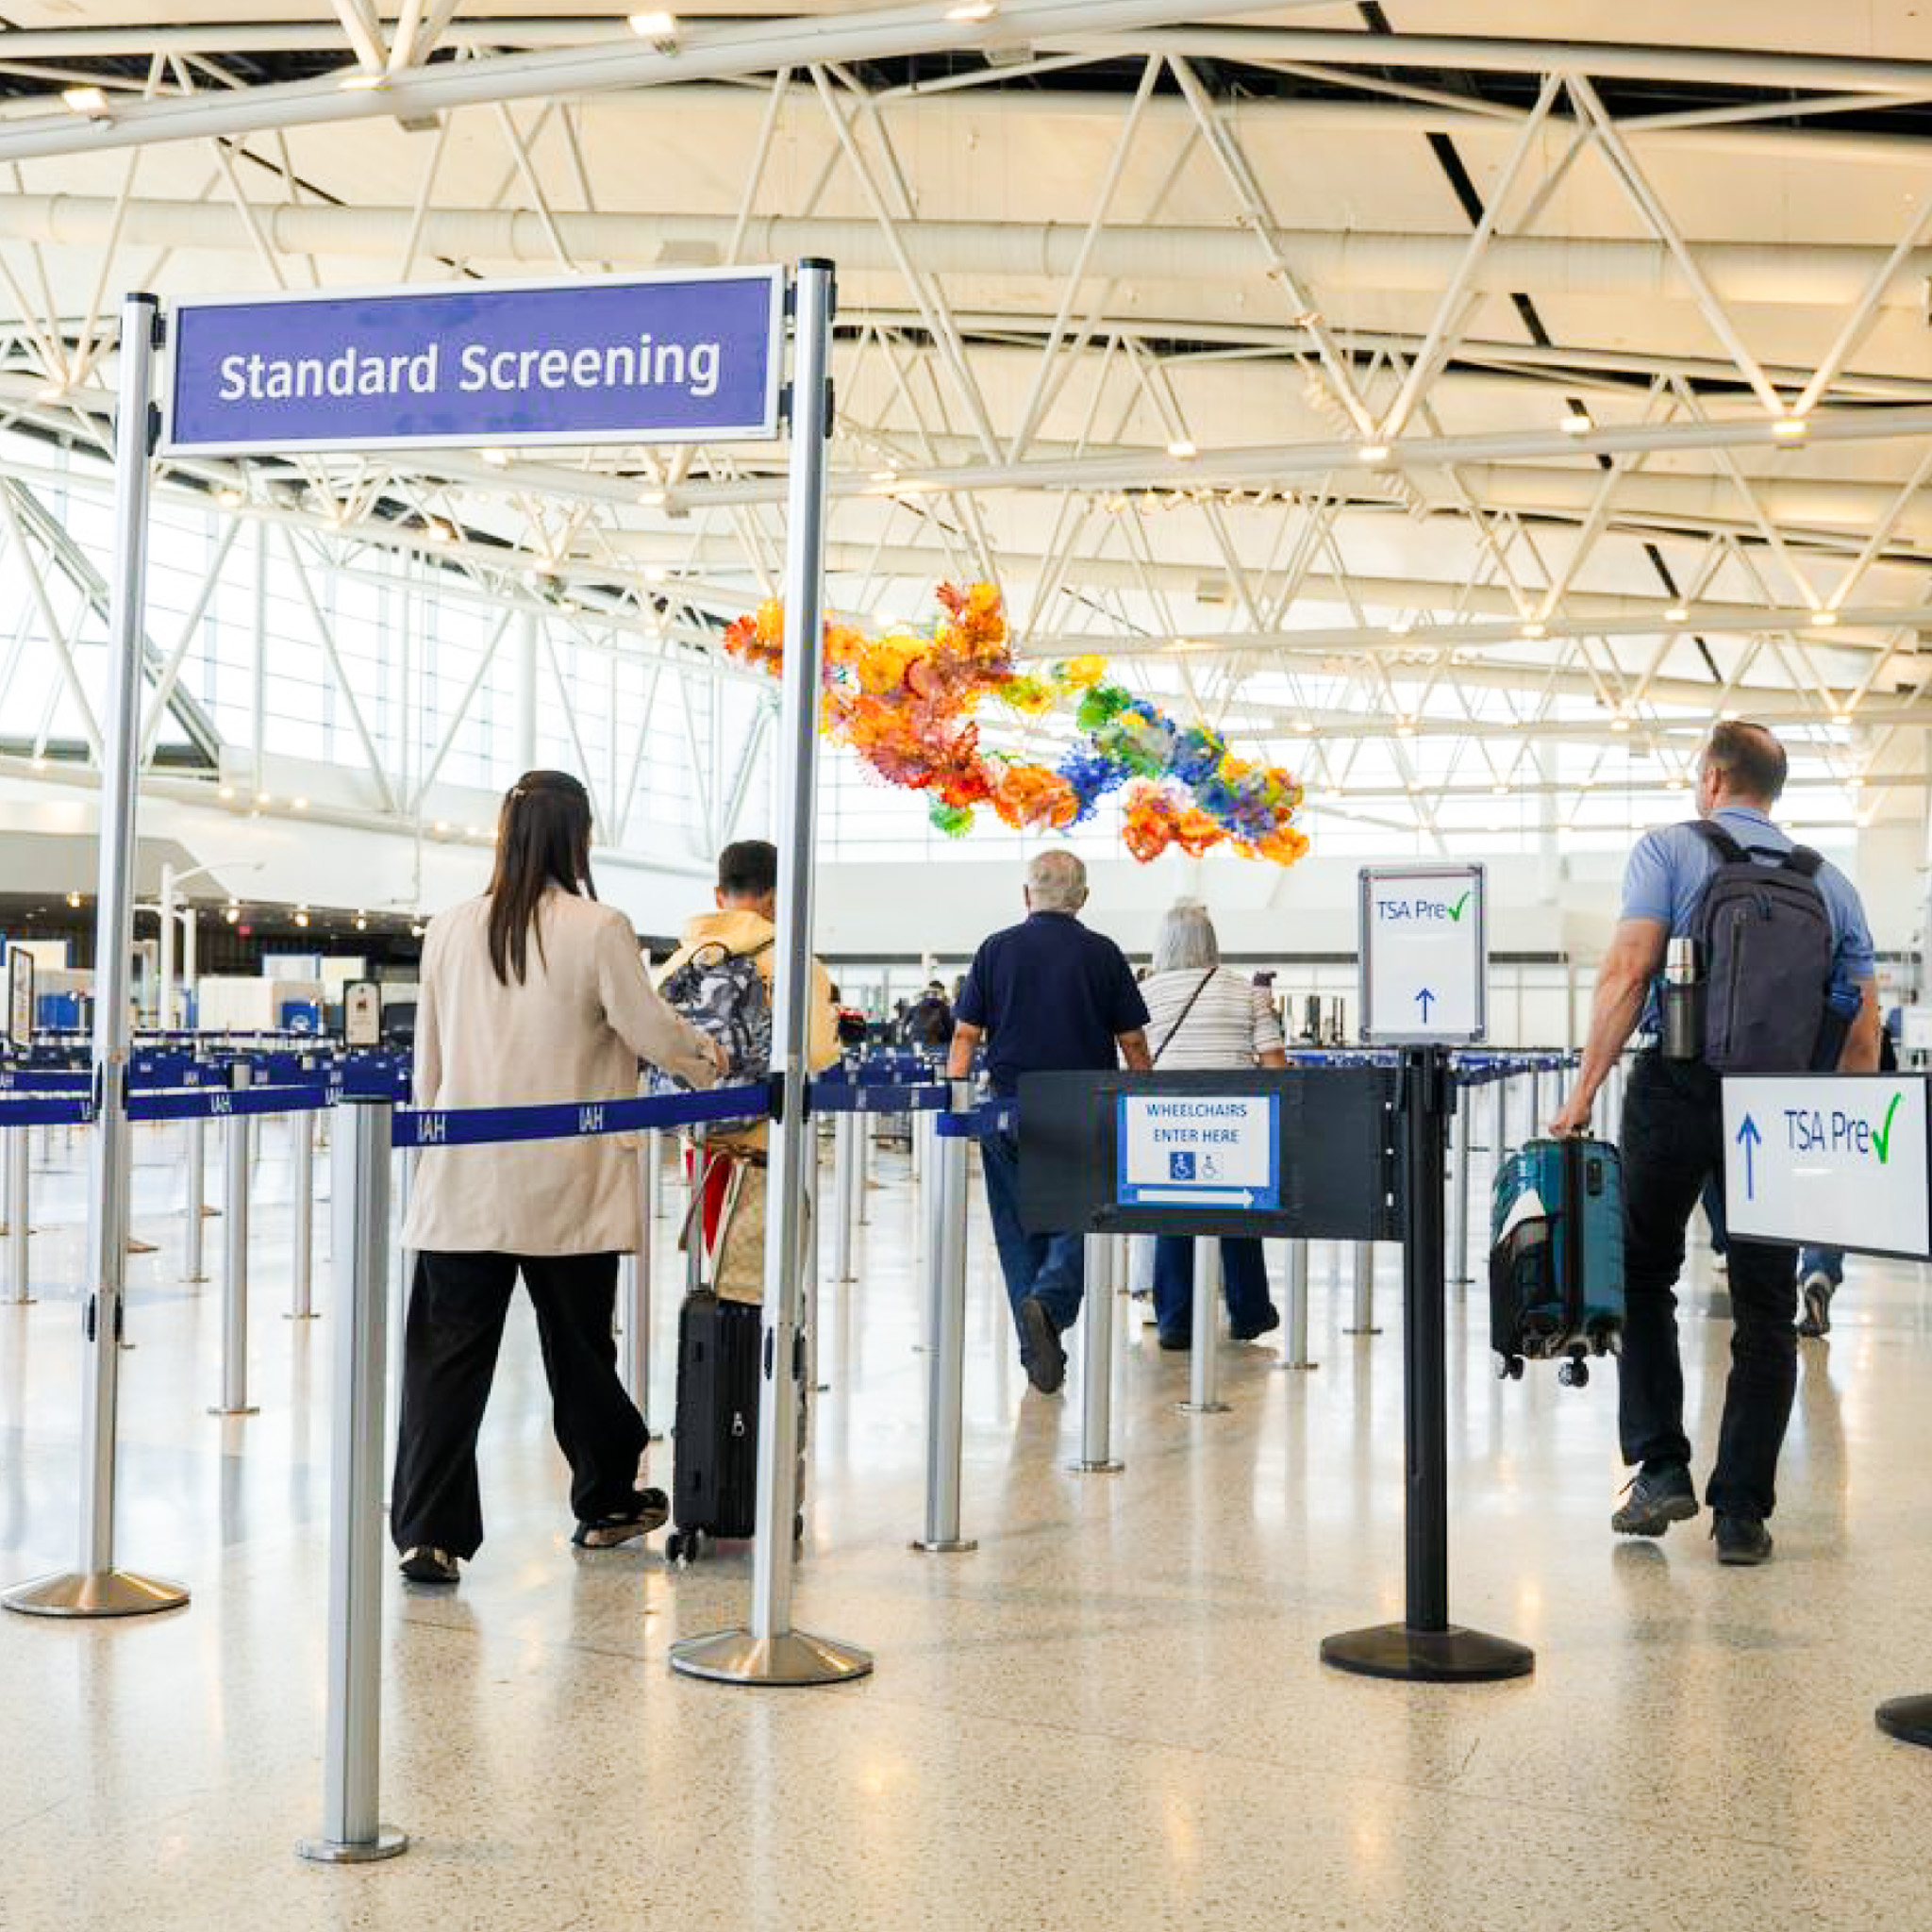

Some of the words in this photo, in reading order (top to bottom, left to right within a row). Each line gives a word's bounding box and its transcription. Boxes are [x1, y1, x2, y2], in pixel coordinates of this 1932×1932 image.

[218, 343, 439, 401] Standard
[459, 333, 721, 396] Screening
[1376, 901, 1411, 920] TSA
[1416, 901, 1446, 920] Pre
[211, 1093, 232, 1113] IAH
[1145, 1103, 1248, 1118] WHEELCHAIRS
[417, 1113, 446, 1143] IAH
[578, 1104, 603, 1133] IAH
[1153, 1129, 1199, 1142] ENTER
[1202, 1129, 1240, 1143] HERE
[1784, 1109, 1825, 1151] TSA
[1832, 1111, 1869, 1154] Pre
